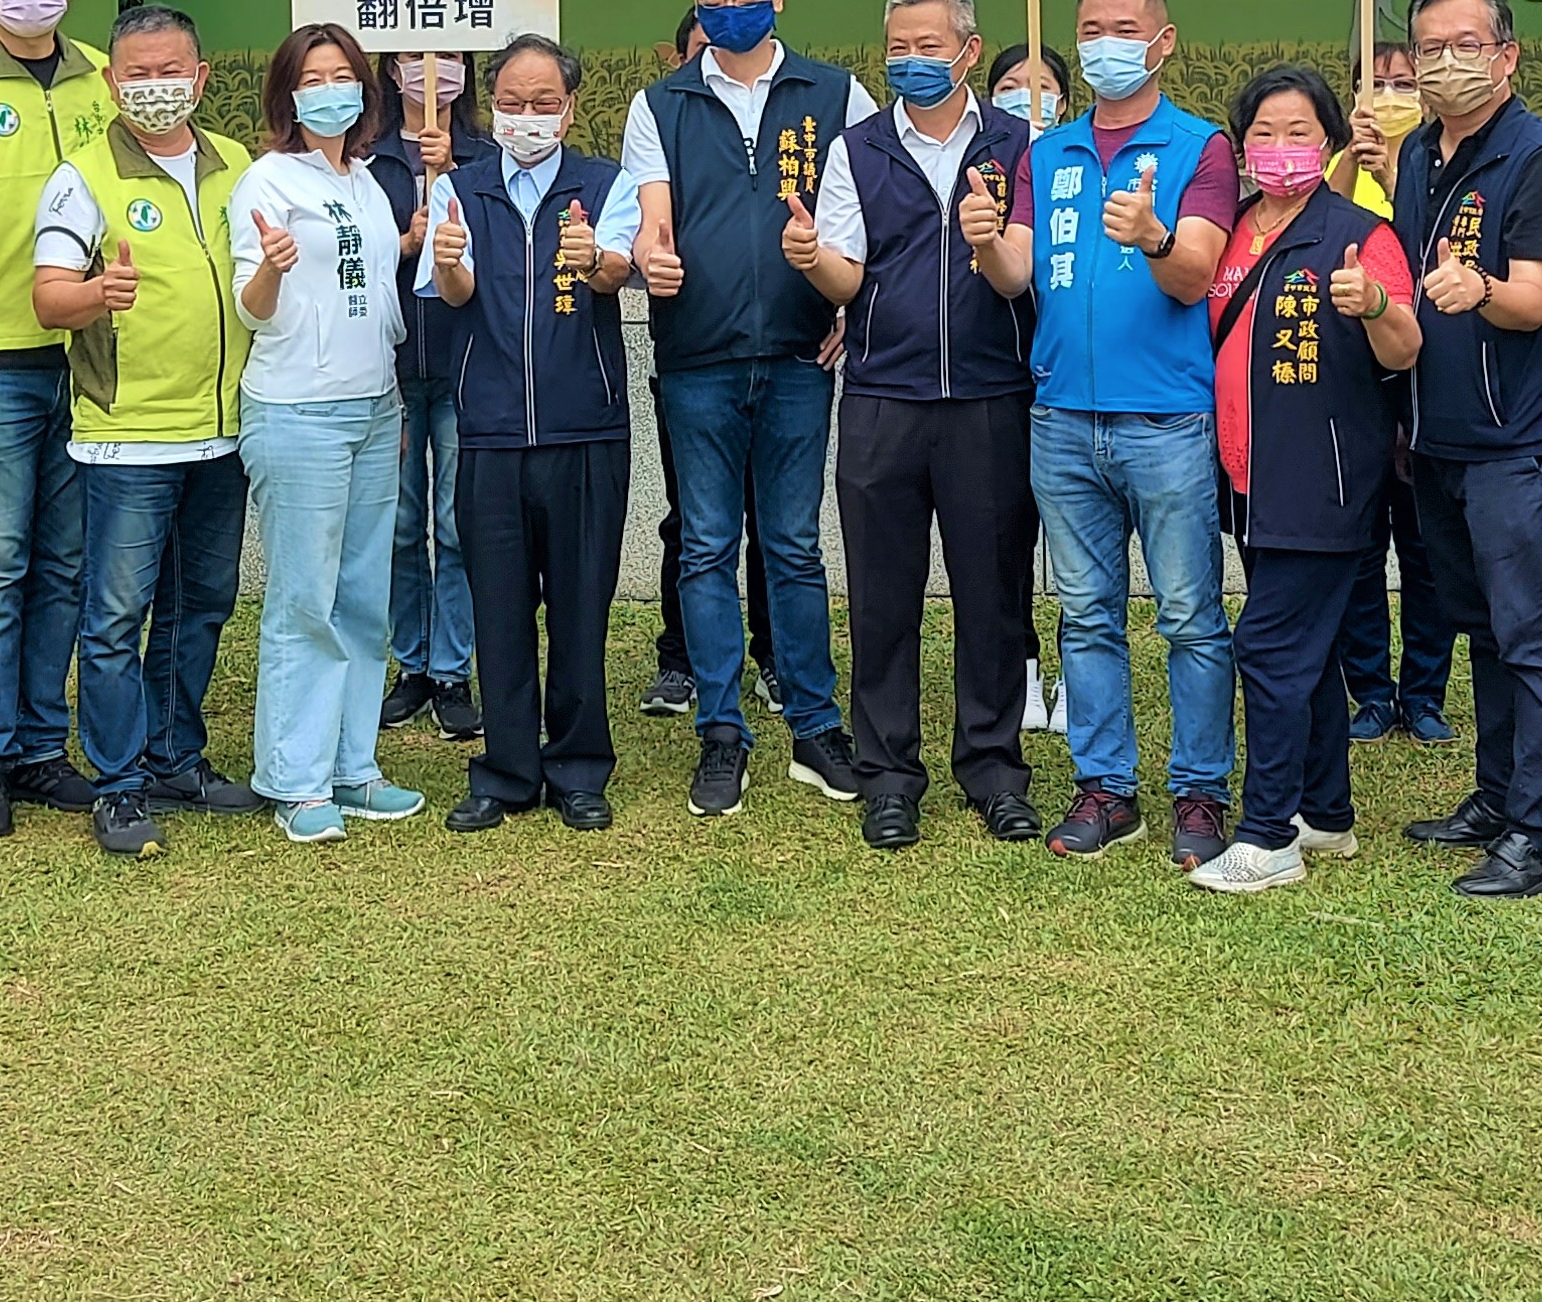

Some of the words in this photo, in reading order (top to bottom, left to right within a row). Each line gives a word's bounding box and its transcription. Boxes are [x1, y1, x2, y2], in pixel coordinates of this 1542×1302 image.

[322, 198, 367, 291] 林靜儀
[1297, 294, 1321, 384] 市政顧問
